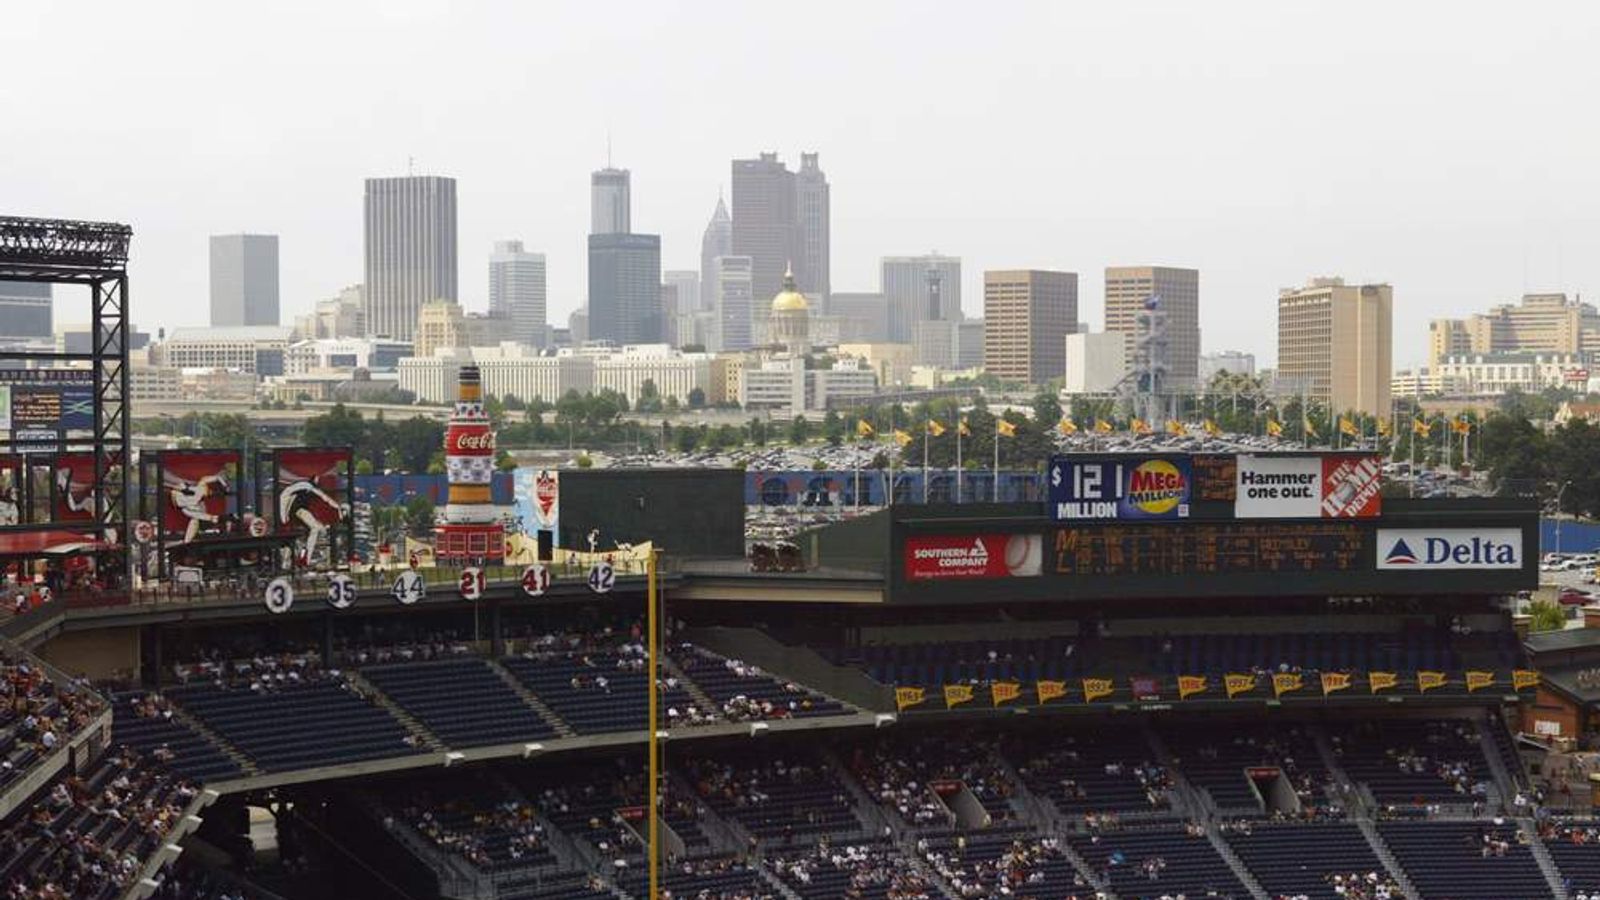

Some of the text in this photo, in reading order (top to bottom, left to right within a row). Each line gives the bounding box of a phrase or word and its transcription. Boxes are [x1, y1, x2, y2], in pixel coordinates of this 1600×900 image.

[1052, 465, 1061, 487] $
[1131, 470, 1185, 491] MEGA
[1241, 471, 1317, 485] Hammer
[1327, 460, 1352, 486] THE
[1247, 487, 1313, 499] one out.
[1344, 477, 1381, 517] DEPOT
[1058, 502, 1117, 519] MILLION
[914, 548, 967, 559] SOUTHERN
[1424, 537, 1516, 564] Delta
[939, 558, 989, 567] COMPANY
[392, 576, 424, 598] 44
[460, 571, 485, 595] 21
[522, 569, 549, 591] 41
[589, 566, 613, 589] 42
[272, 586, 284, 606] 3
[329, 581, 356, 602] 35
